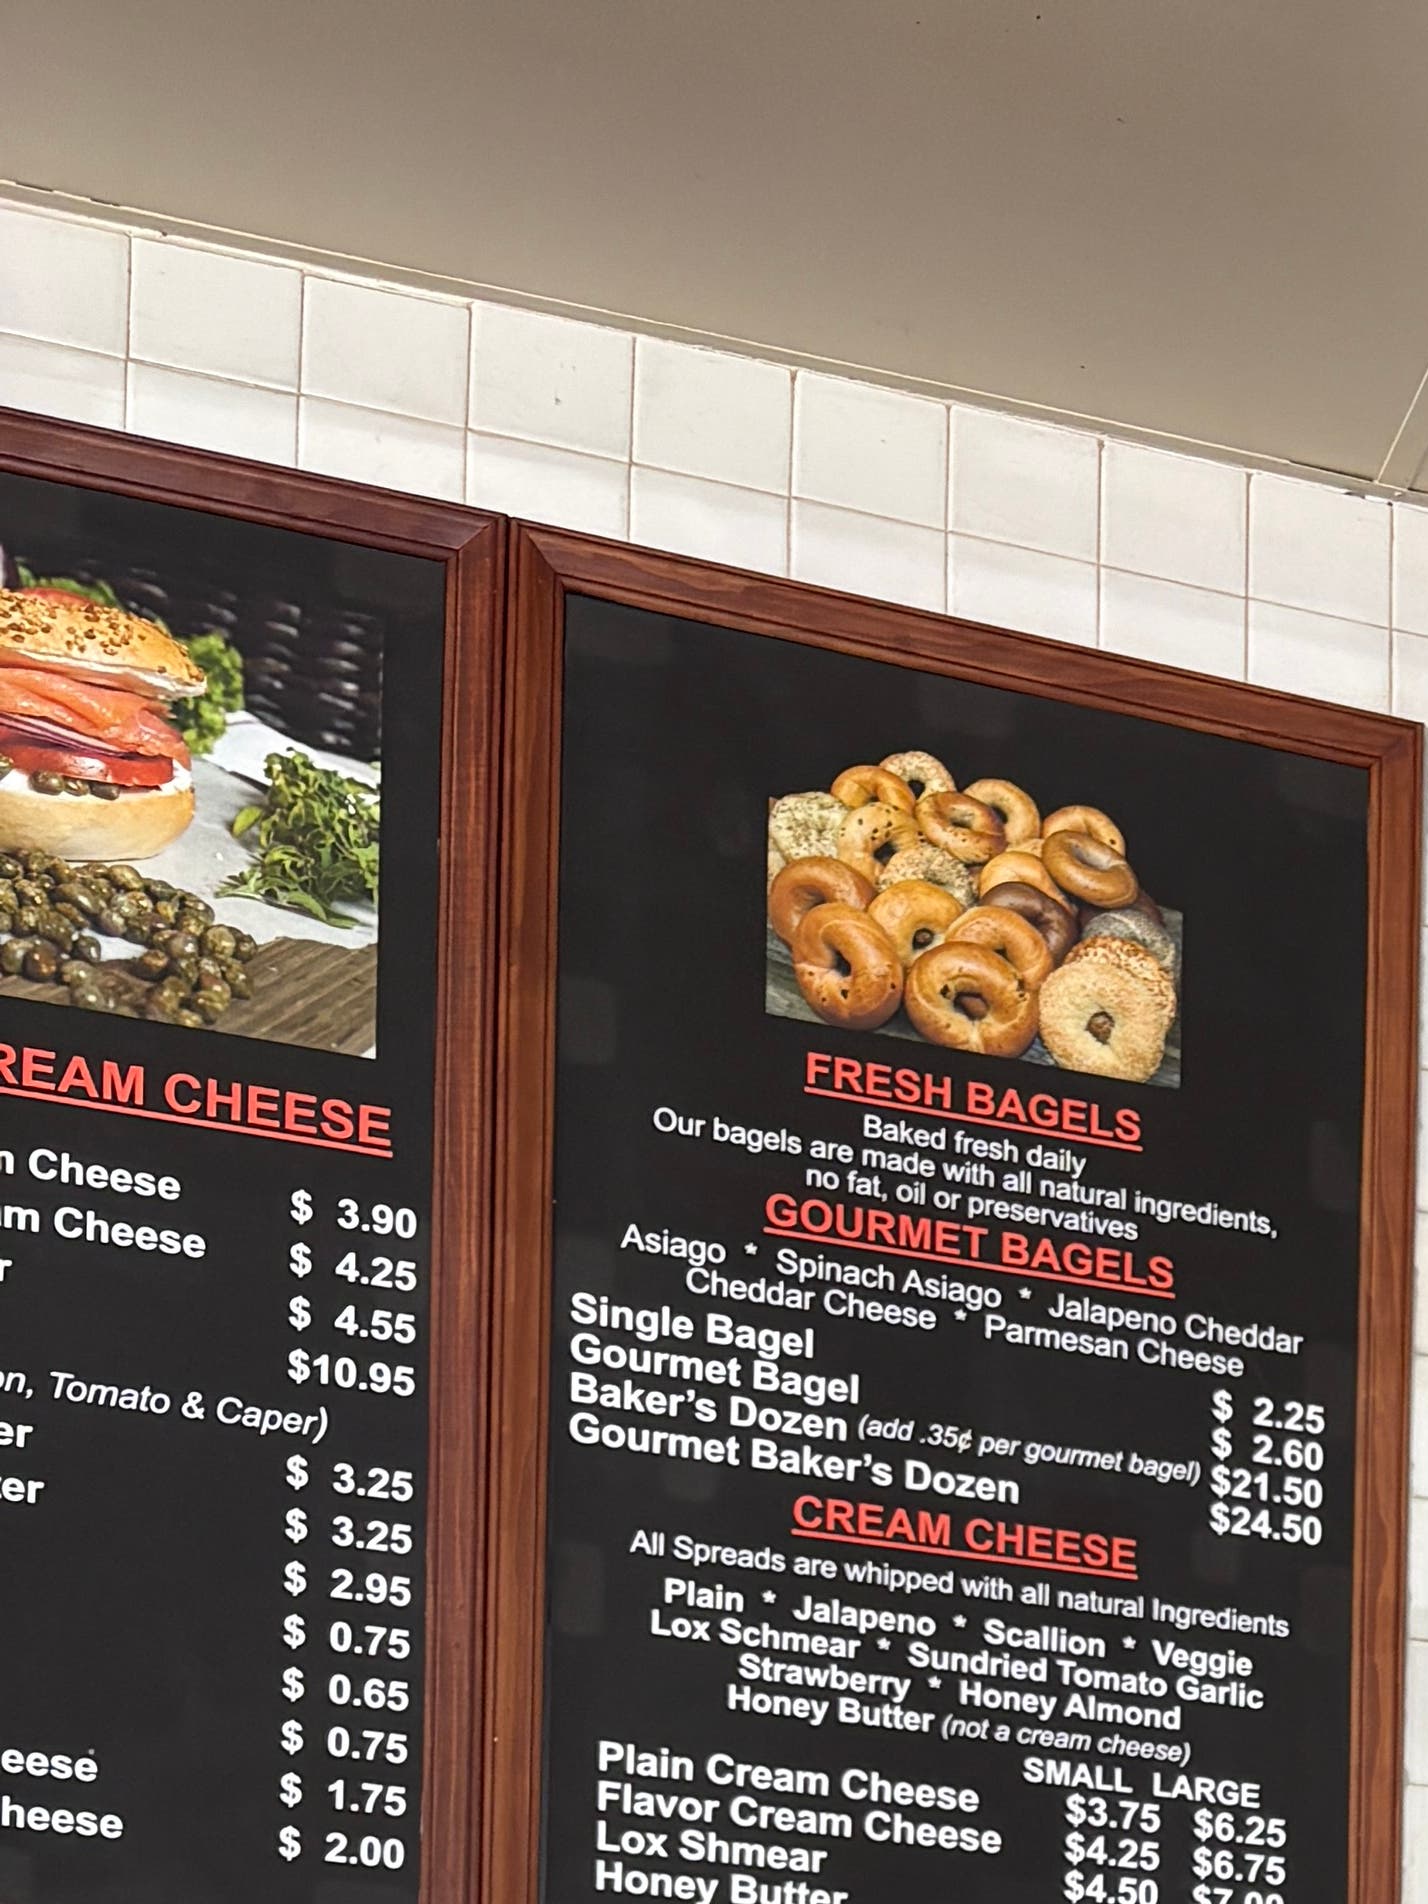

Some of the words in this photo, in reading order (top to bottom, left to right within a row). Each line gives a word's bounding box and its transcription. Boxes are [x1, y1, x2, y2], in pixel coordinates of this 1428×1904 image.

[165, 1073, 391, 1147] CHEESE
[807, 1052, 951, 1109] FRESH
[968, 1081, 1140, 1142] BAGELS
[654, 1107, 706, 1137] Our
[714, 1117, 801, 1154] bagels
[810, 1140, 853, 1164] are
[862, 1149, 935, 1178] made
[943, 1161, 994, 1187] with
[1003, 1170, 1031, 1194] all
[1040, 1179, 1126, 1210] natural
[1135, 1190, 1276, 1239] ingredients,
[864, 1114, 945, 1150] Baked
[954, 1130, 1018, 1163] fresh
[1026, 1144, 1086, 1178] daily
[29, 1148, 180, 1200] Cheese
[338, 1198, 416, 1239] 3.90
[807, 1168, 839, 1190] no
[847, 1170, 887, 1202] fat,
[896, 1181, 925, 1205] oil
[934, 1191, 961, 1210] or
[968, 1196, 1138, 1241] preservatives
[54, 1206, 205, 1258] Cheese
[766, 1193, 988, 1259] GOURMET
[1002, 1231, 1174, 1295] BAGELS
[336, 1252, 416, 1292] 4.25
[621, 1223, 726, 1265] Asiago
[777, 1248, 894, 1291] Spinach
[902, 1269, 1001, 1311] Asiago
[1049, 1293, 1176, 1335] Jalapeno
[1185, 1313, 1303, 1354] Cheddar
[335, 1304, 415, 1344] 4.55
[571, 1292, 693, 1342] Single
[707, 1313, 813, 1361] Bagel
[686, 1260, 815, 1310] Cheddar
[824, 1288, 936, 1330] Cheese
[985, 1313, 1128, 1359] Parmesan
[1138, 1337, 1244, 1377] Cheese
[288, 1348, 415, 1397] $10.95
[571, 1332, 741, 1387] Gourmet
[753, 1359, 859, 1404] Bagel
[50, 1371, 170, 1414] Tomato
[182, 1391, 204, 1420] &
[217, 1397, 327, 1444] Caper)
[571, 1371, 716, 1423] Baker's
[730, 1395, 847, 1442] Dozen
[1253, 1397, 1325, 1434] 2.25
[570, 1412, 739, 1466] Gourmet
[752, 1438, 892, 1486] Baker's
[906, 1459, 1019, 1504] Dozen
[859, 1414, 914, 1441] (add
[978, 1436, 1021, 1457] per
[1024, 1442, 1123, 1472] gourmet
[1129, 1452, 1200, 1487] bagel)
[1253, 1434, 1323, 1472] 2.60
[333, 1462, 413, 1502] 3.25
[1211, 1464, 1322, 1509] $21.50
[332, 1515, 412, 1555] 3.25
[793, 1495, 950, 1546] CREAM
[965, 1518, 1136, 1571] CHEESE
[1210, 1501, 1322, 1546] $24.50
[330, 1568, 411, 1607] 2.95
[630, 1529, 664, 1556] All
[673, 1535, 785, 1572] Spreads
[794, 1556, 837, 1579] are
[844, 1560, 953, 1594] whipped
[961, 1575, 1013, 1602] with
[1021, 1583, 1049, 1606] all
[1058, 1591, 1143, 1618] natural
[1153, 1598, 1289, 1638] Ingredients
[330, 1621, 410, 1659] 0.75
[665, 1577, 743, 1613] Plain
[793, 1595, 936, 1637] Jalapeno
[984, 1618, 1105, 1658] Scallion
[1152, 1639, 1252, 1679] Veggie
[651, 1609, 710, 1641] Lox
[719, 1617, 861, 1658] Schmear
[908, 1641, 1047, 1682] Sundried
[1056, 1659, 1167, 1697] Tomato
[1176, 1674, 1263, 1710] Garlic
[329, 1674, 409, 1712] 0.65
[728, 1683, 829, 1725] Honey
[839, 1696, 935, 1733] Butter
[739, 1652, 911, 1701] Strawberry
[960, 1679, 1057, 1718] Honey
[1064, 1693, 1180, 1730] Almond
[328, 1726, 407, 1764] 0.75
[942, 1714, 989, 1740] (not
[994, 1725, 1010, 1742] a
[1017, 1727, 1091, 1751] cream
[1097, 1733, 1190, 1768] cheese)
[328, 1779, 406, 1817] 1.75
[599, 1740, 693, 1781] Plain
[707, 1753, 829, 1796] Cream
[842, 1768, 979, 1813] Cheese
[1023, 1757, 1133, 1794] SMALL
[1153, 1772, 1260, 1809] LARGE
[598, 1780, 720, 1822] Flavor
[730, 1795, 852, 1838] Cream
[865, 1810, 1001, 1854] Cheese
[1066, 1792, 1160, 1833] $3.75
[1194, 1808, 1286, 1848] $6.25
[325, 1832, 404, 1869] 2.00
[597, 1820, 668, 1858] Lox
[679, 1829, 827, 1873] Shmear
[1065, 1831, 1159, 1871] $4.25
[1193, 1846, 1285, 1885] $6.75
